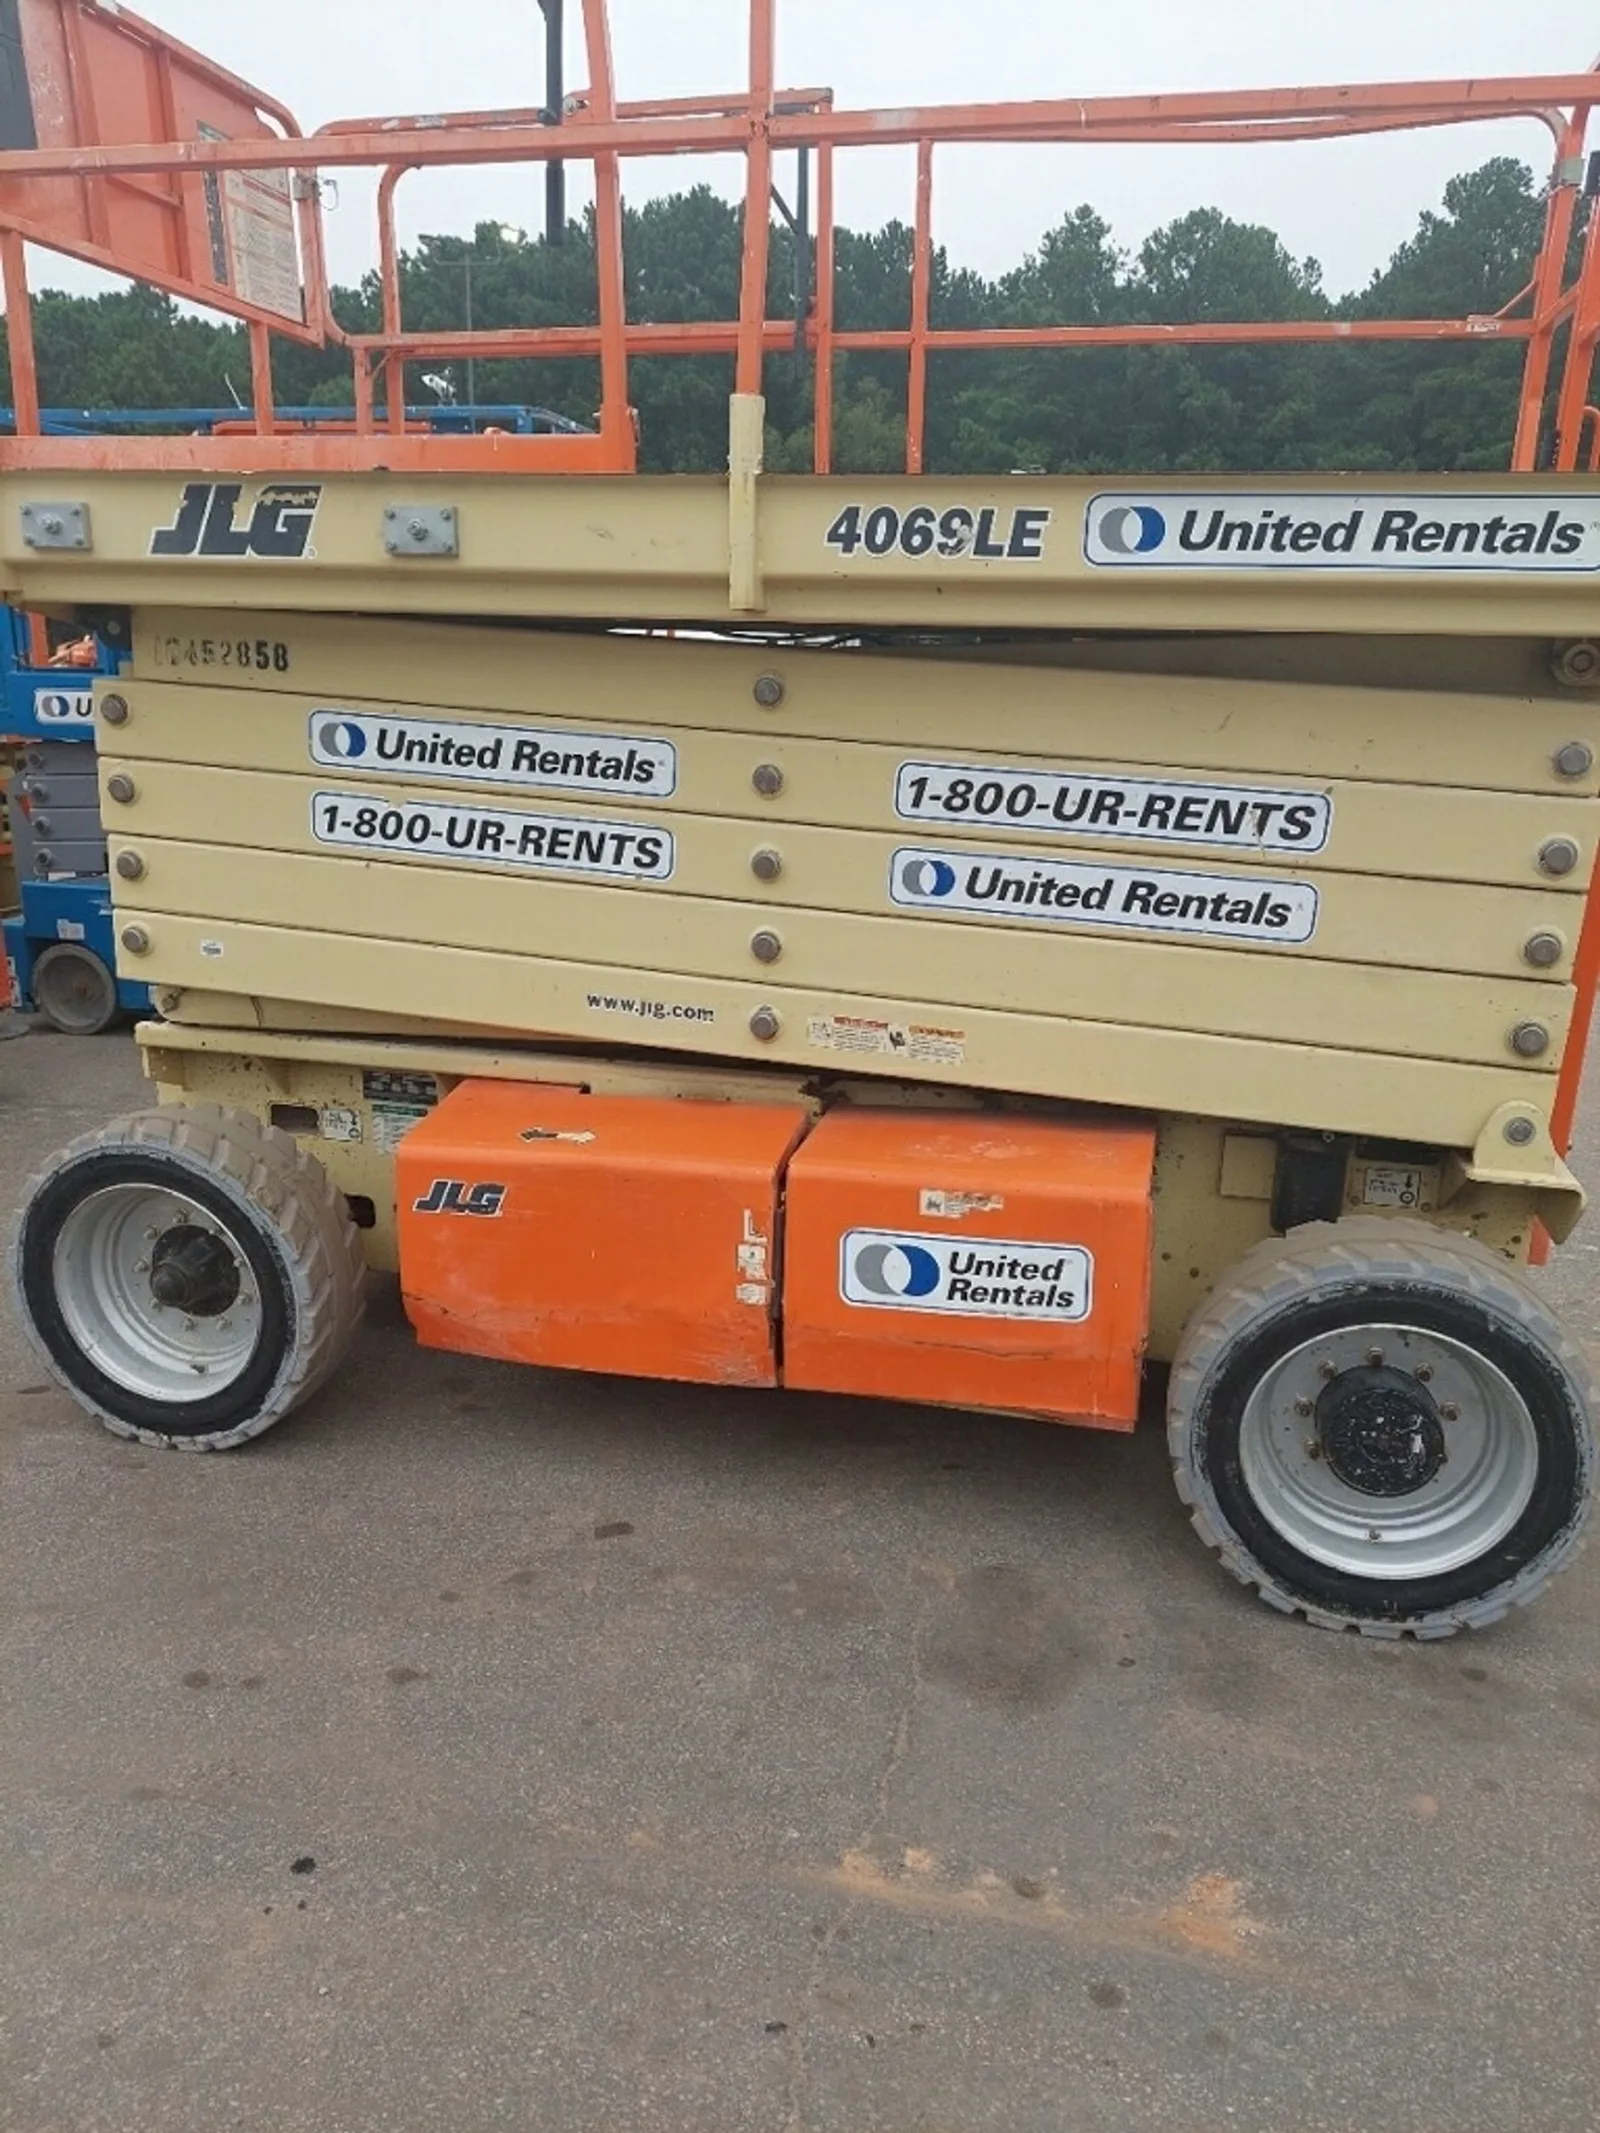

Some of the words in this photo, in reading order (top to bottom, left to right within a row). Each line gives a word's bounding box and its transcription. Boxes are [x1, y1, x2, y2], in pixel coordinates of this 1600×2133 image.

[151, 483, 322, 557] JLG
[827, 506, 1049, 557] 4069LE
[1179, 509, 1363, 553] United
[1372, 509, 1584, 556] Rentals
[376, 728, 503, 769] United
[511, 739, 656, 783] Rentals
[908, 776, 1317, 841] 1-800-UR-RENTS
[322, 805, 663, 869] 1-800-UR-RENTS
[965, 866, 1113, 911] United
[1121, 878, 1292, 929] Rentals
[587, 994, 714, 1022] www.jlg.com
[415, 1180, 506, 1215] JLG
[949, 1251, 1065, 1282] United
[947, 1279, 1074, 1308] Rentals
